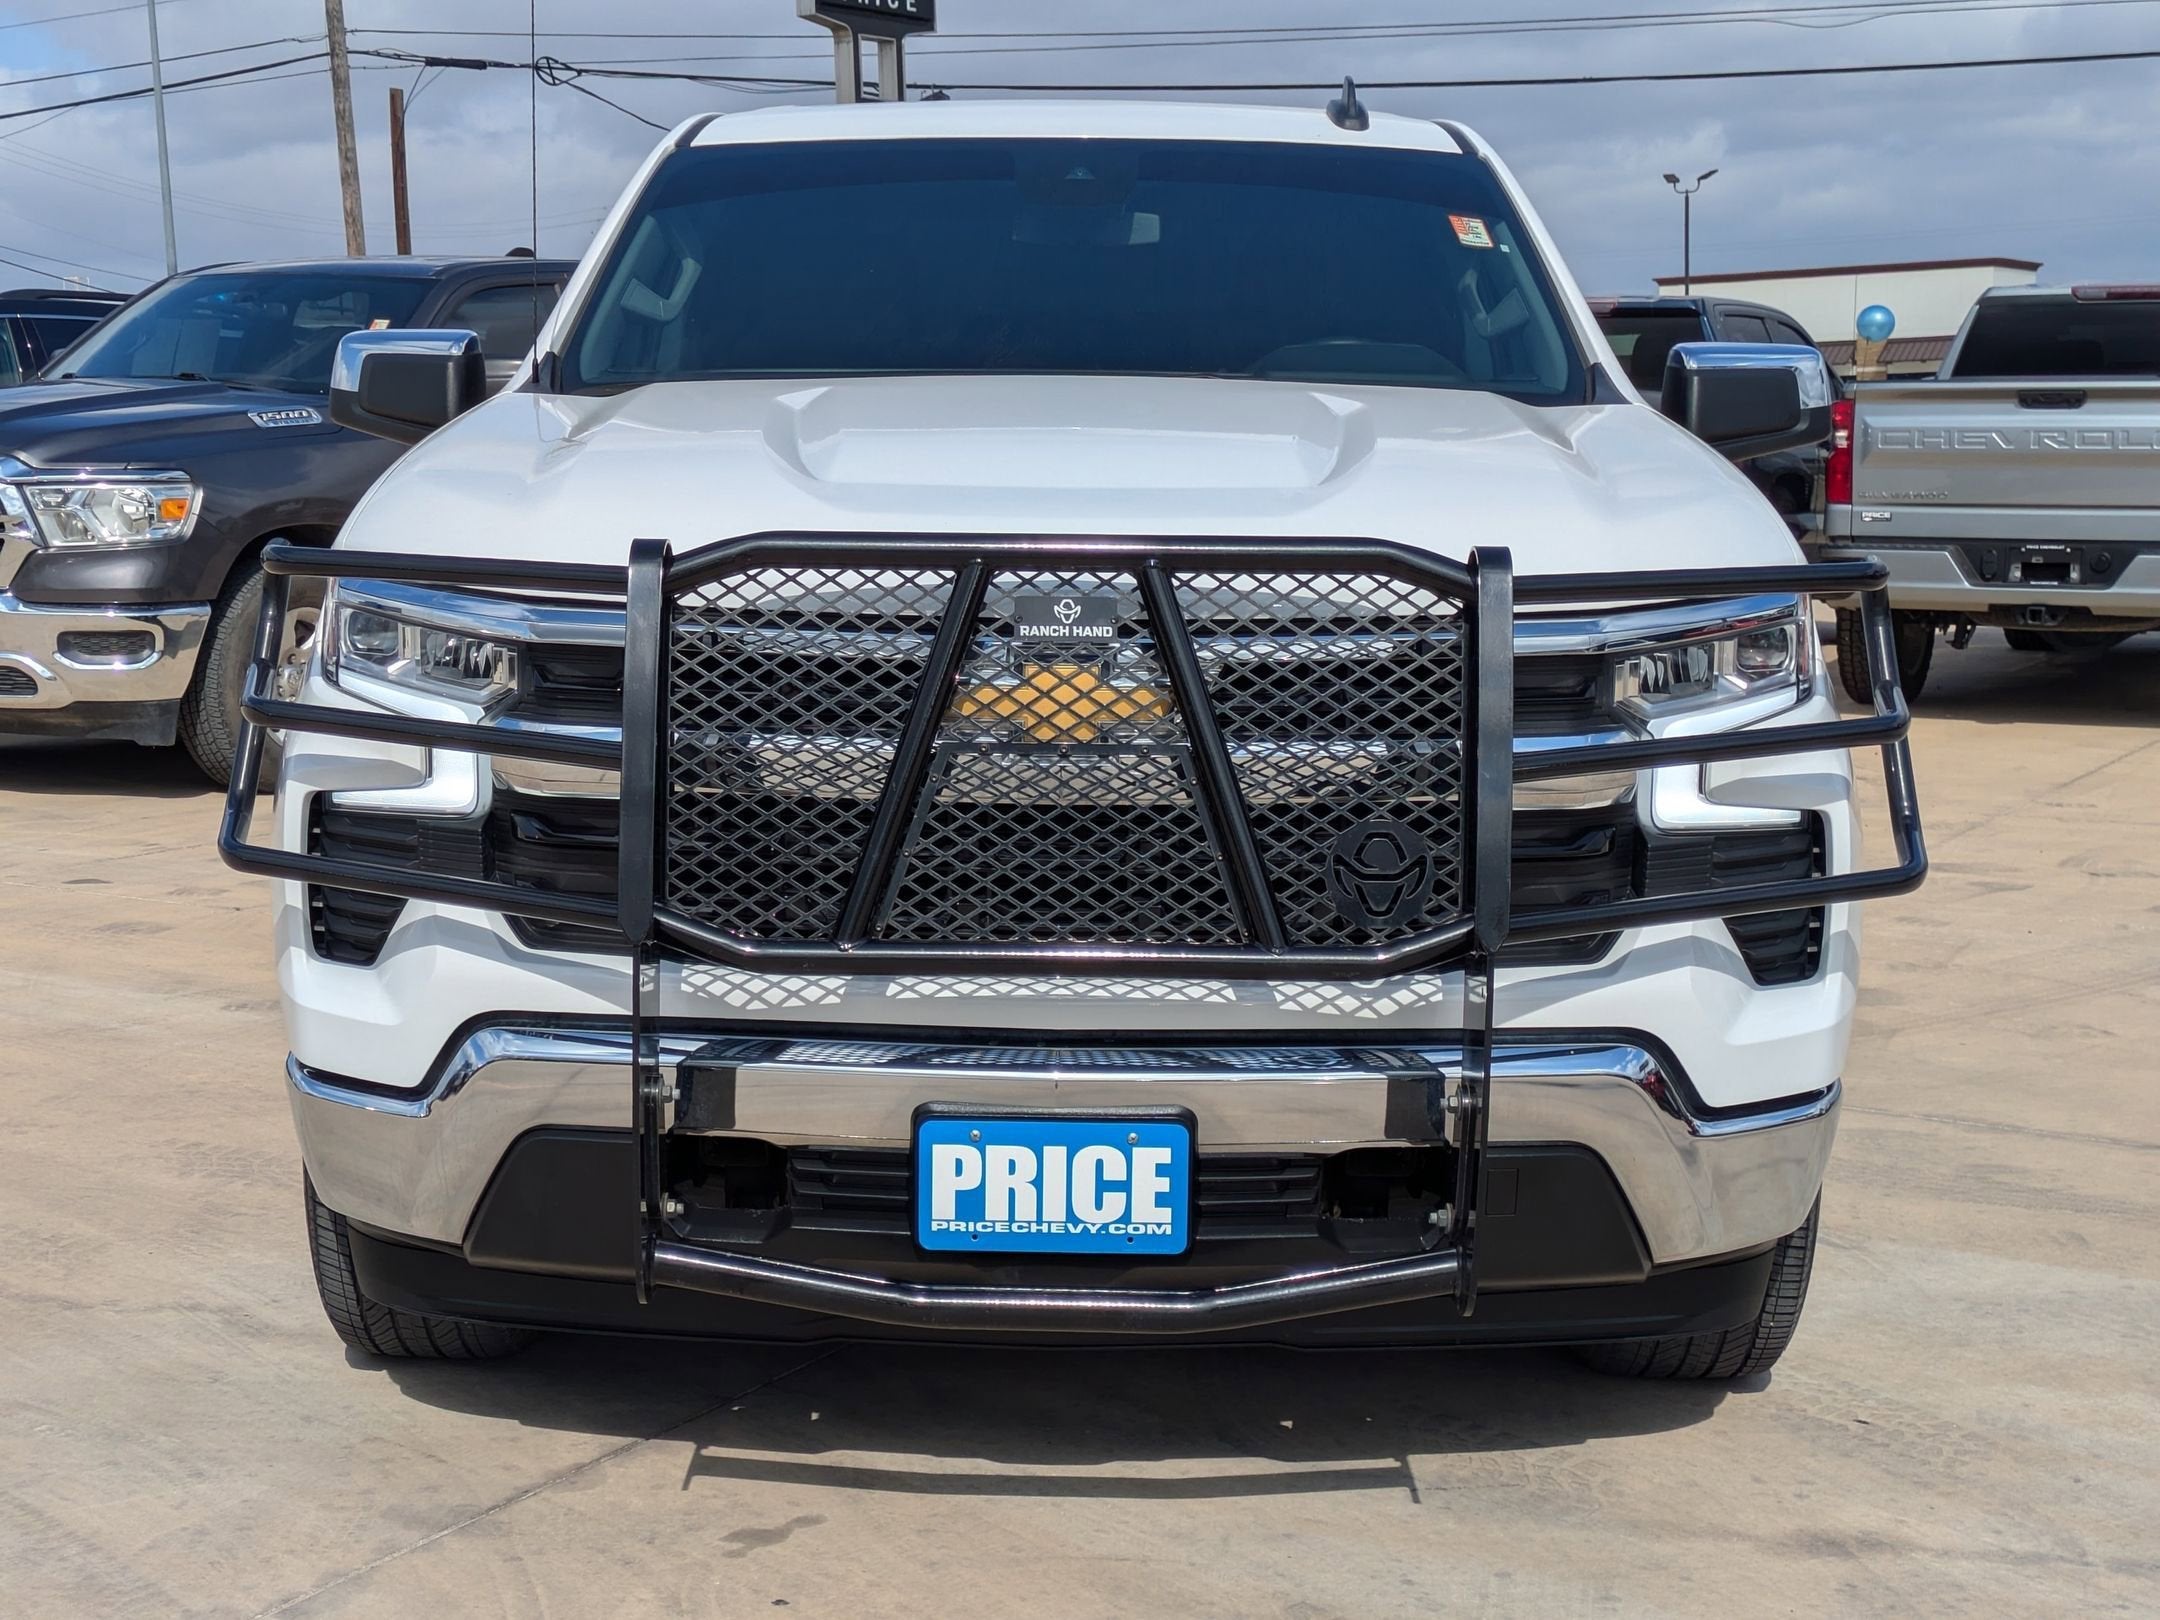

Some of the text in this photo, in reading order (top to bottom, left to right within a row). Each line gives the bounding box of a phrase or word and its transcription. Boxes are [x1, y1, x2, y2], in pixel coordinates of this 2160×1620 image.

[258, 410, 309, 421] 1500
[1878, 430, 2160, 450] CHEVROL
[1020, 625, 1113, 637] RANCH HAND
[931, 1144, 1172, 1223] PRICE
[931, 1220, 1172, 1235] PRICECHEVY.COM
